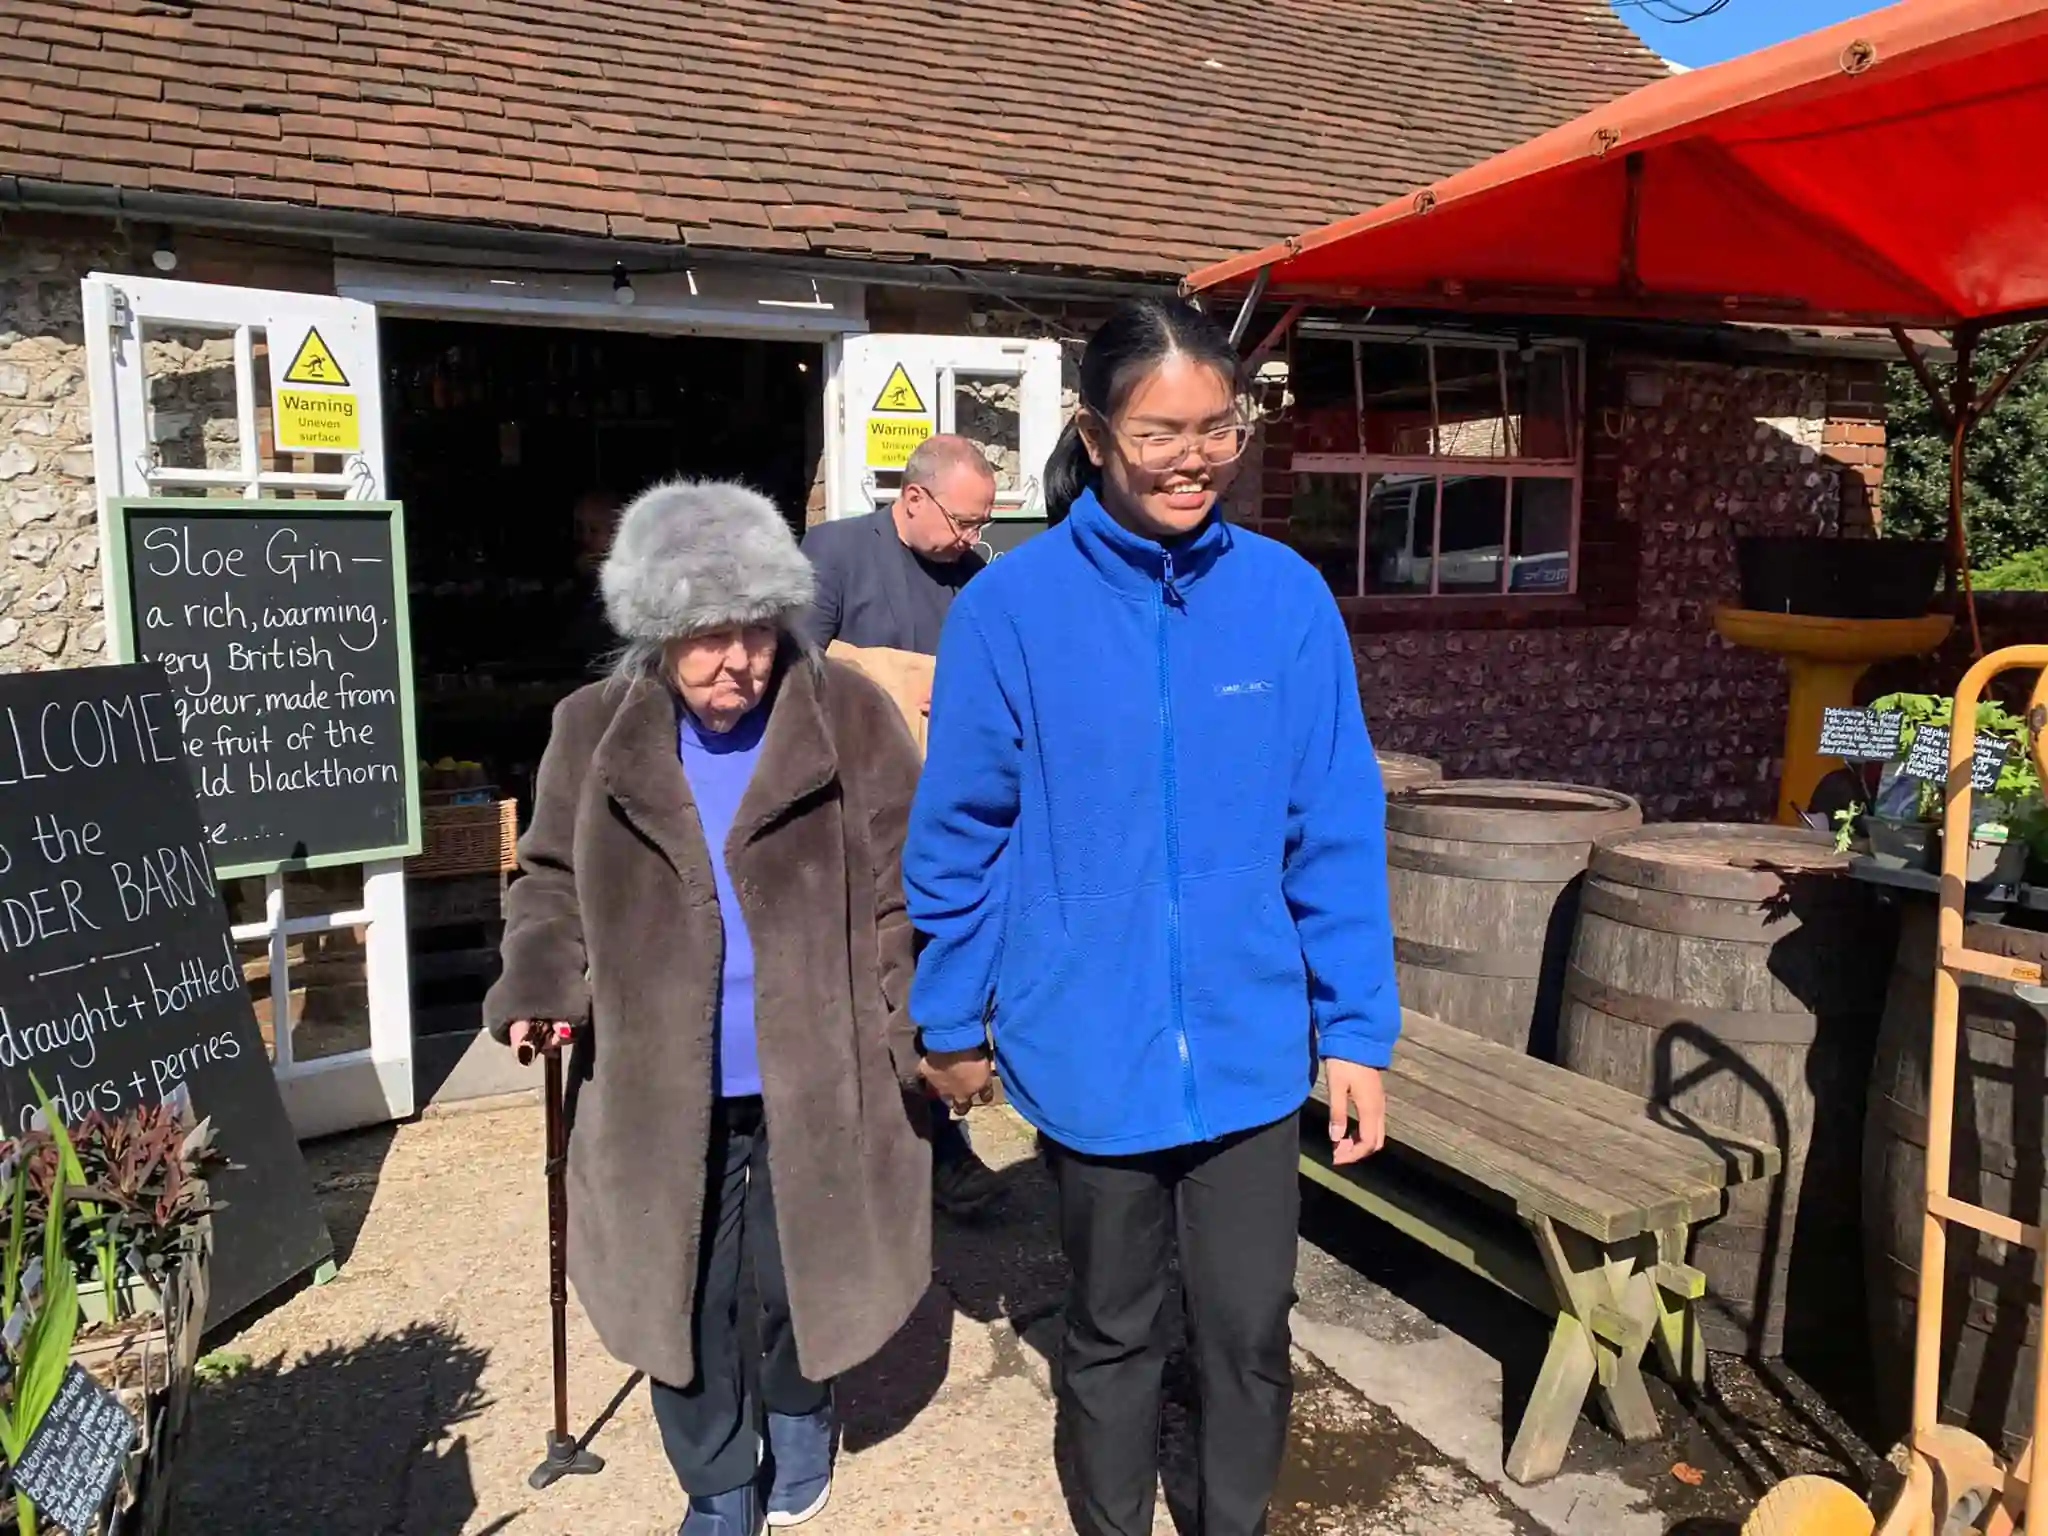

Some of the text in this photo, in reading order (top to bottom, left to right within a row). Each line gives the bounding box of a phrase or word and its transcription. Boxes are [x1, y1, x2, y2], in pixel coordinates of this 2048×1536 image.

[283, 395, 353, 417] Warning
[298, 417, 341, 428] Uneven
[300, 432, 341, 442] surface
[871, 423, 928, 439] Warning
[144, 526, 246, 577] Sloe
[266, 528, 342, 583] Gin
[146, 604, 174, 628] a
[142, 636, 335, 697] ery British
[265, 680, 331, 711] made
[335, 672, 395, 709] from
[0, 693, 177, 785] LCOME
[211, 725, 273, 756] fruit
[286, 722, 315, 750] of
[324, 719, 375, 748] the
[249, 758, 398, 793] blackthorn
[32, 812, 105, 863] the
[111, 841, 216, 922] BARN
[0, 985, 127, 1068] draught
[143, 932, 240, 1016] bottled
[151, 1031, 241, 1100] perries
